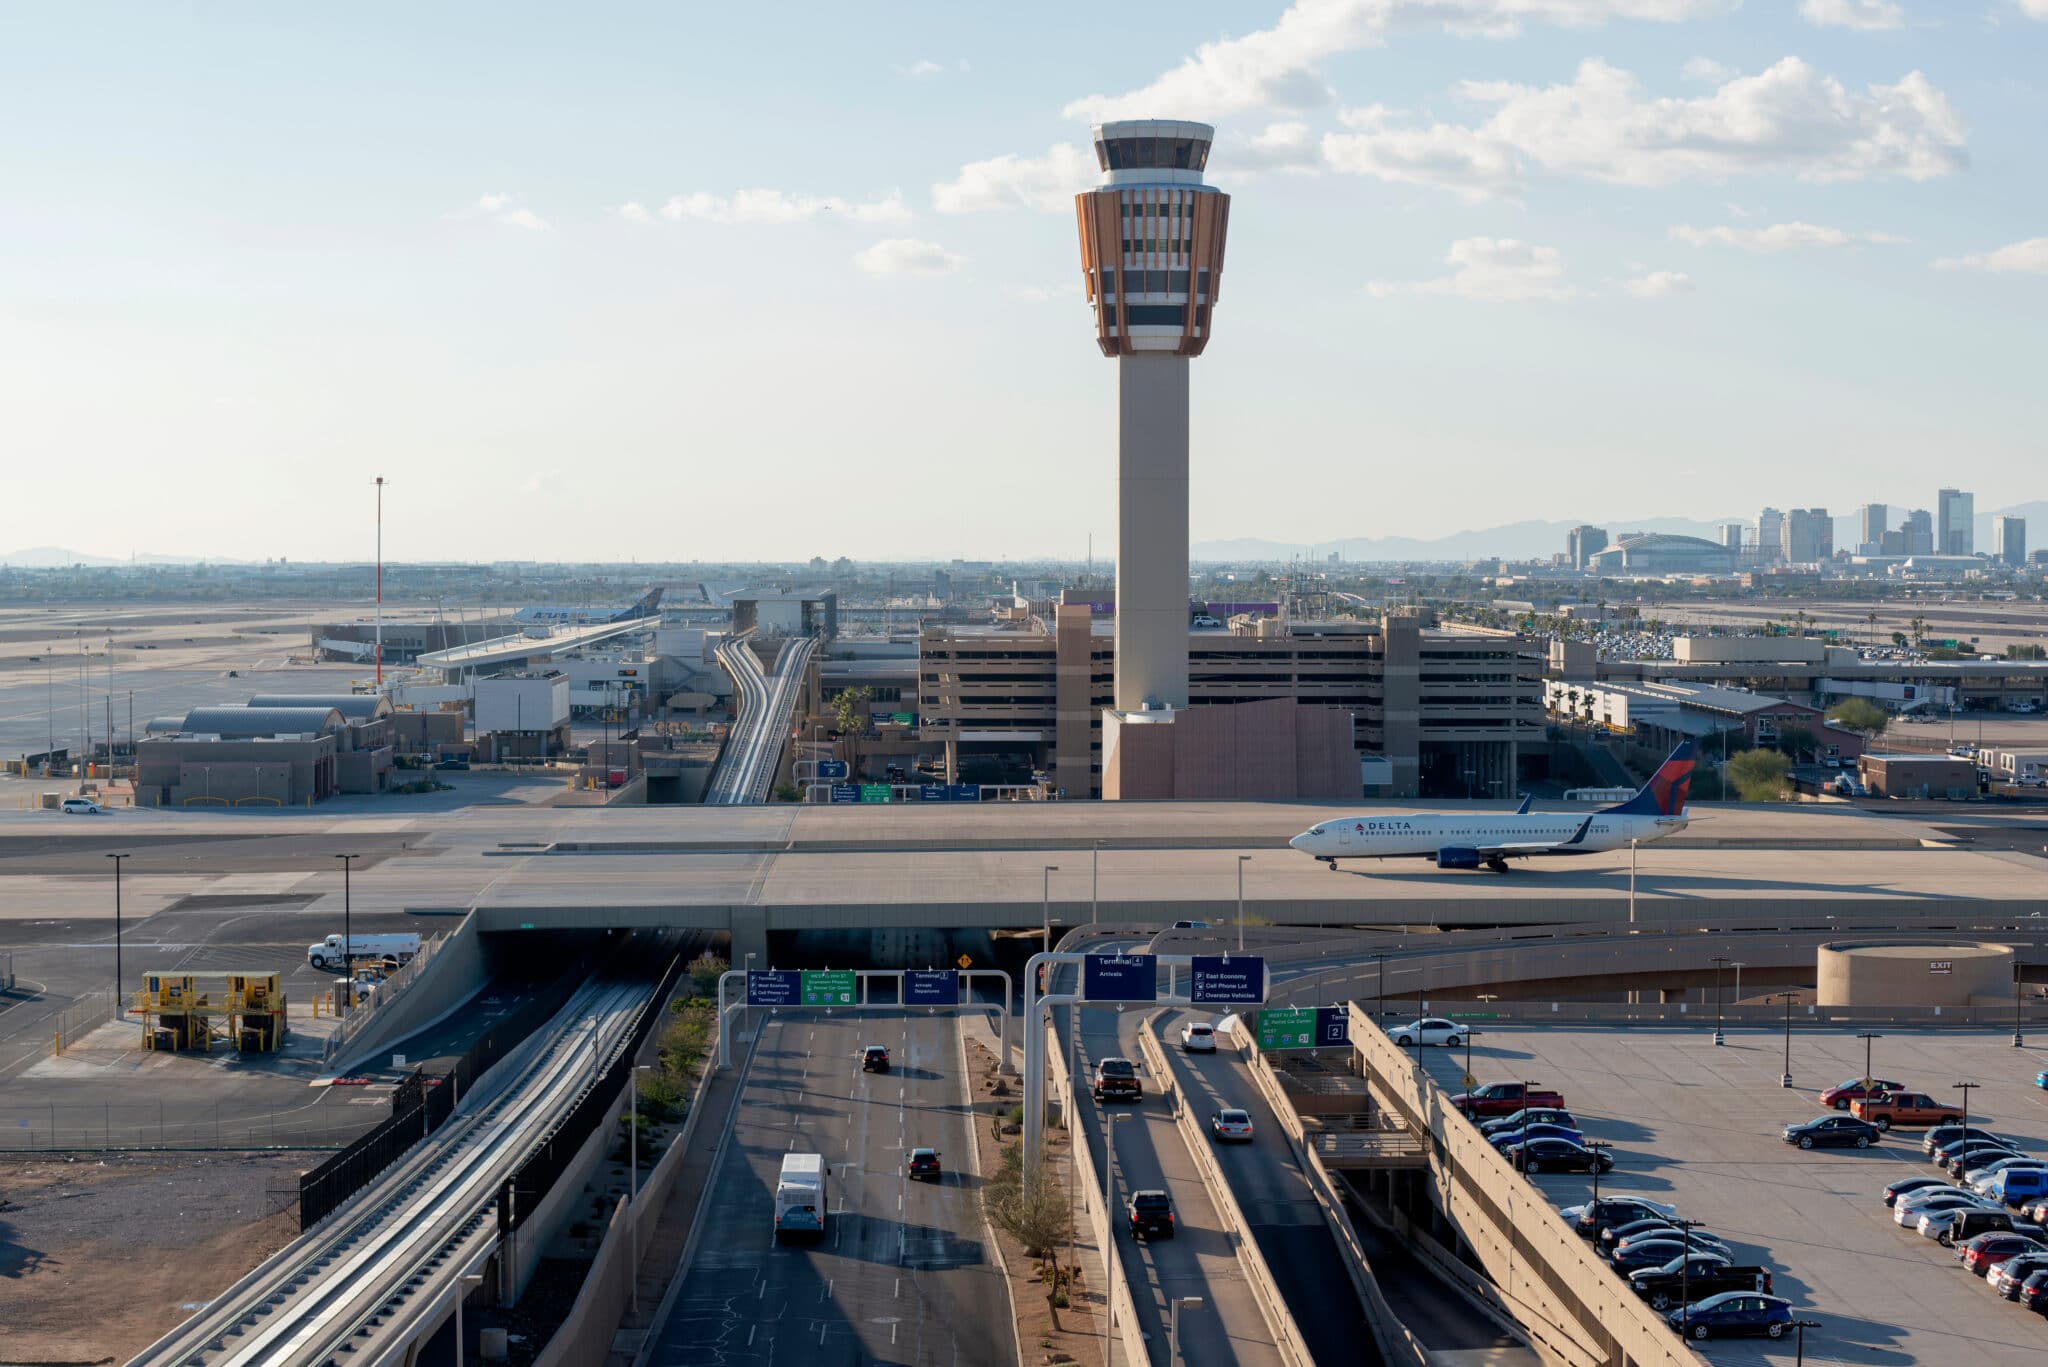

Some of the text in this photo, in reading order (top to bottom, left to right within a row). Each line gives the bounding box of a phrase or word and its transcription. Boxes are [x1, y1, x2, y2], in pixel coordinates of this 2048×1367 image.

[1368, 822, 1412, 830] DELTA
[1099, 957, 1132, 965] Termnal
[1220, 973, 1247, 981] Economy
[1332, 1027, 1339, 1037] 2
